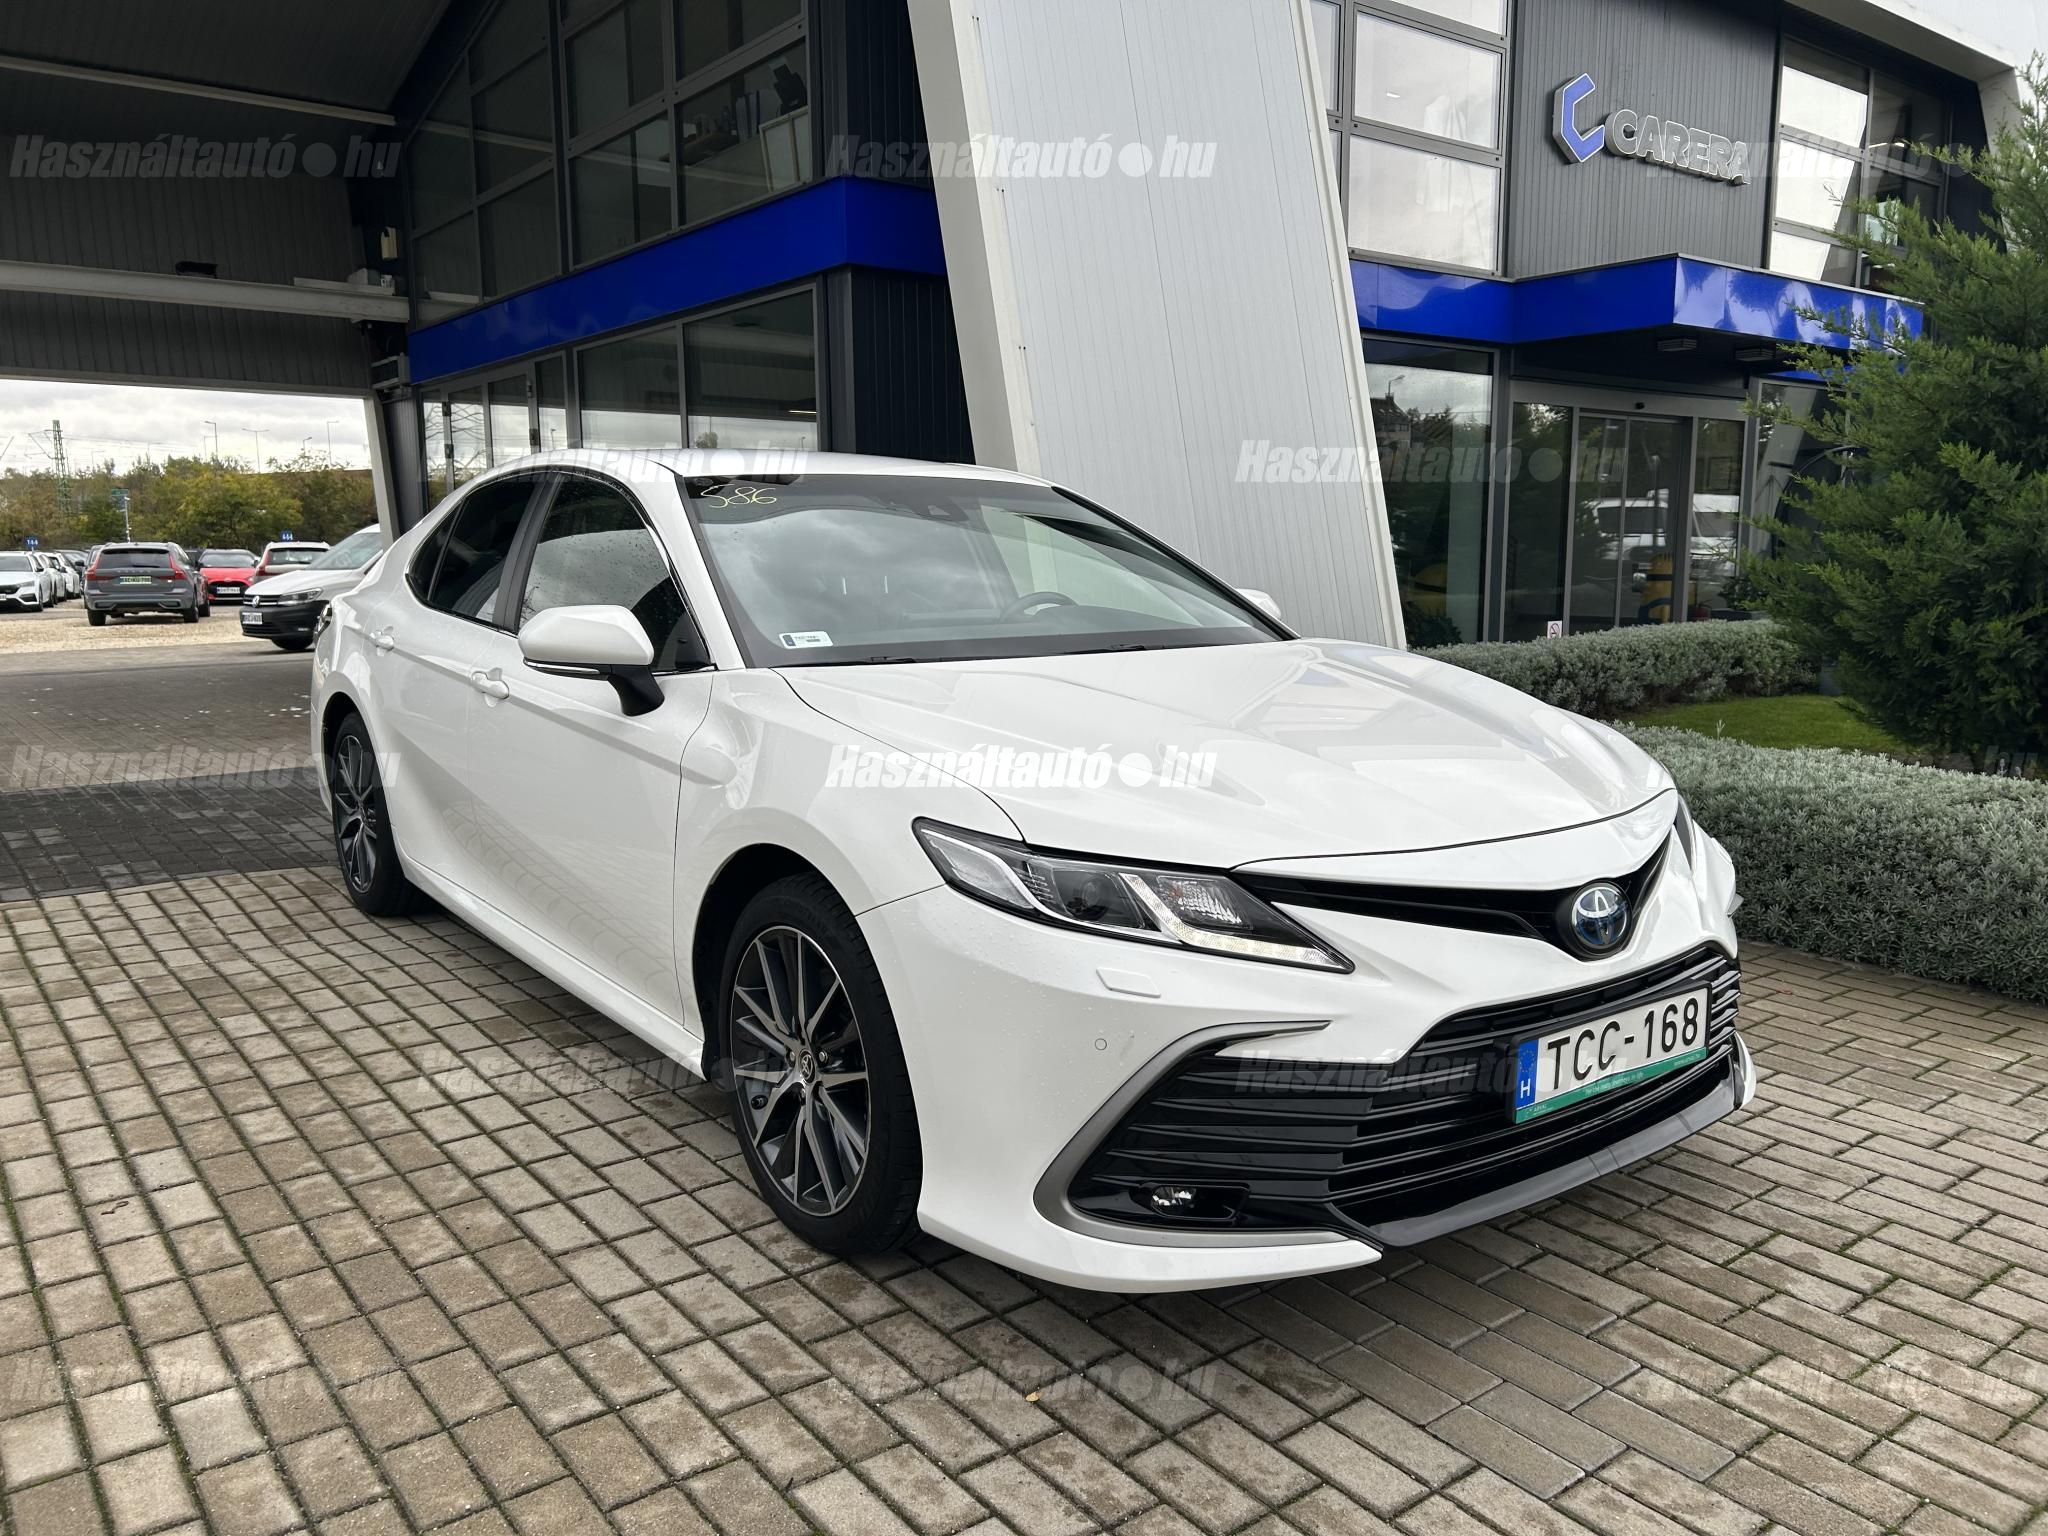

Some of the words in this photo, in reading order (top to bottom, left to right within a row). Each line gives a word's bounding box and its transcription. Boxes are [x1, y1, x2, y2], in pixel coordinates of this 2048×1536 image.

[1605, 109, 1750, 185] CARERA
[700, 483, 777, 508] 586
[1548, 997, 1699, 1090] TCC-168
[1520, 1077, 1531, 1099] H
